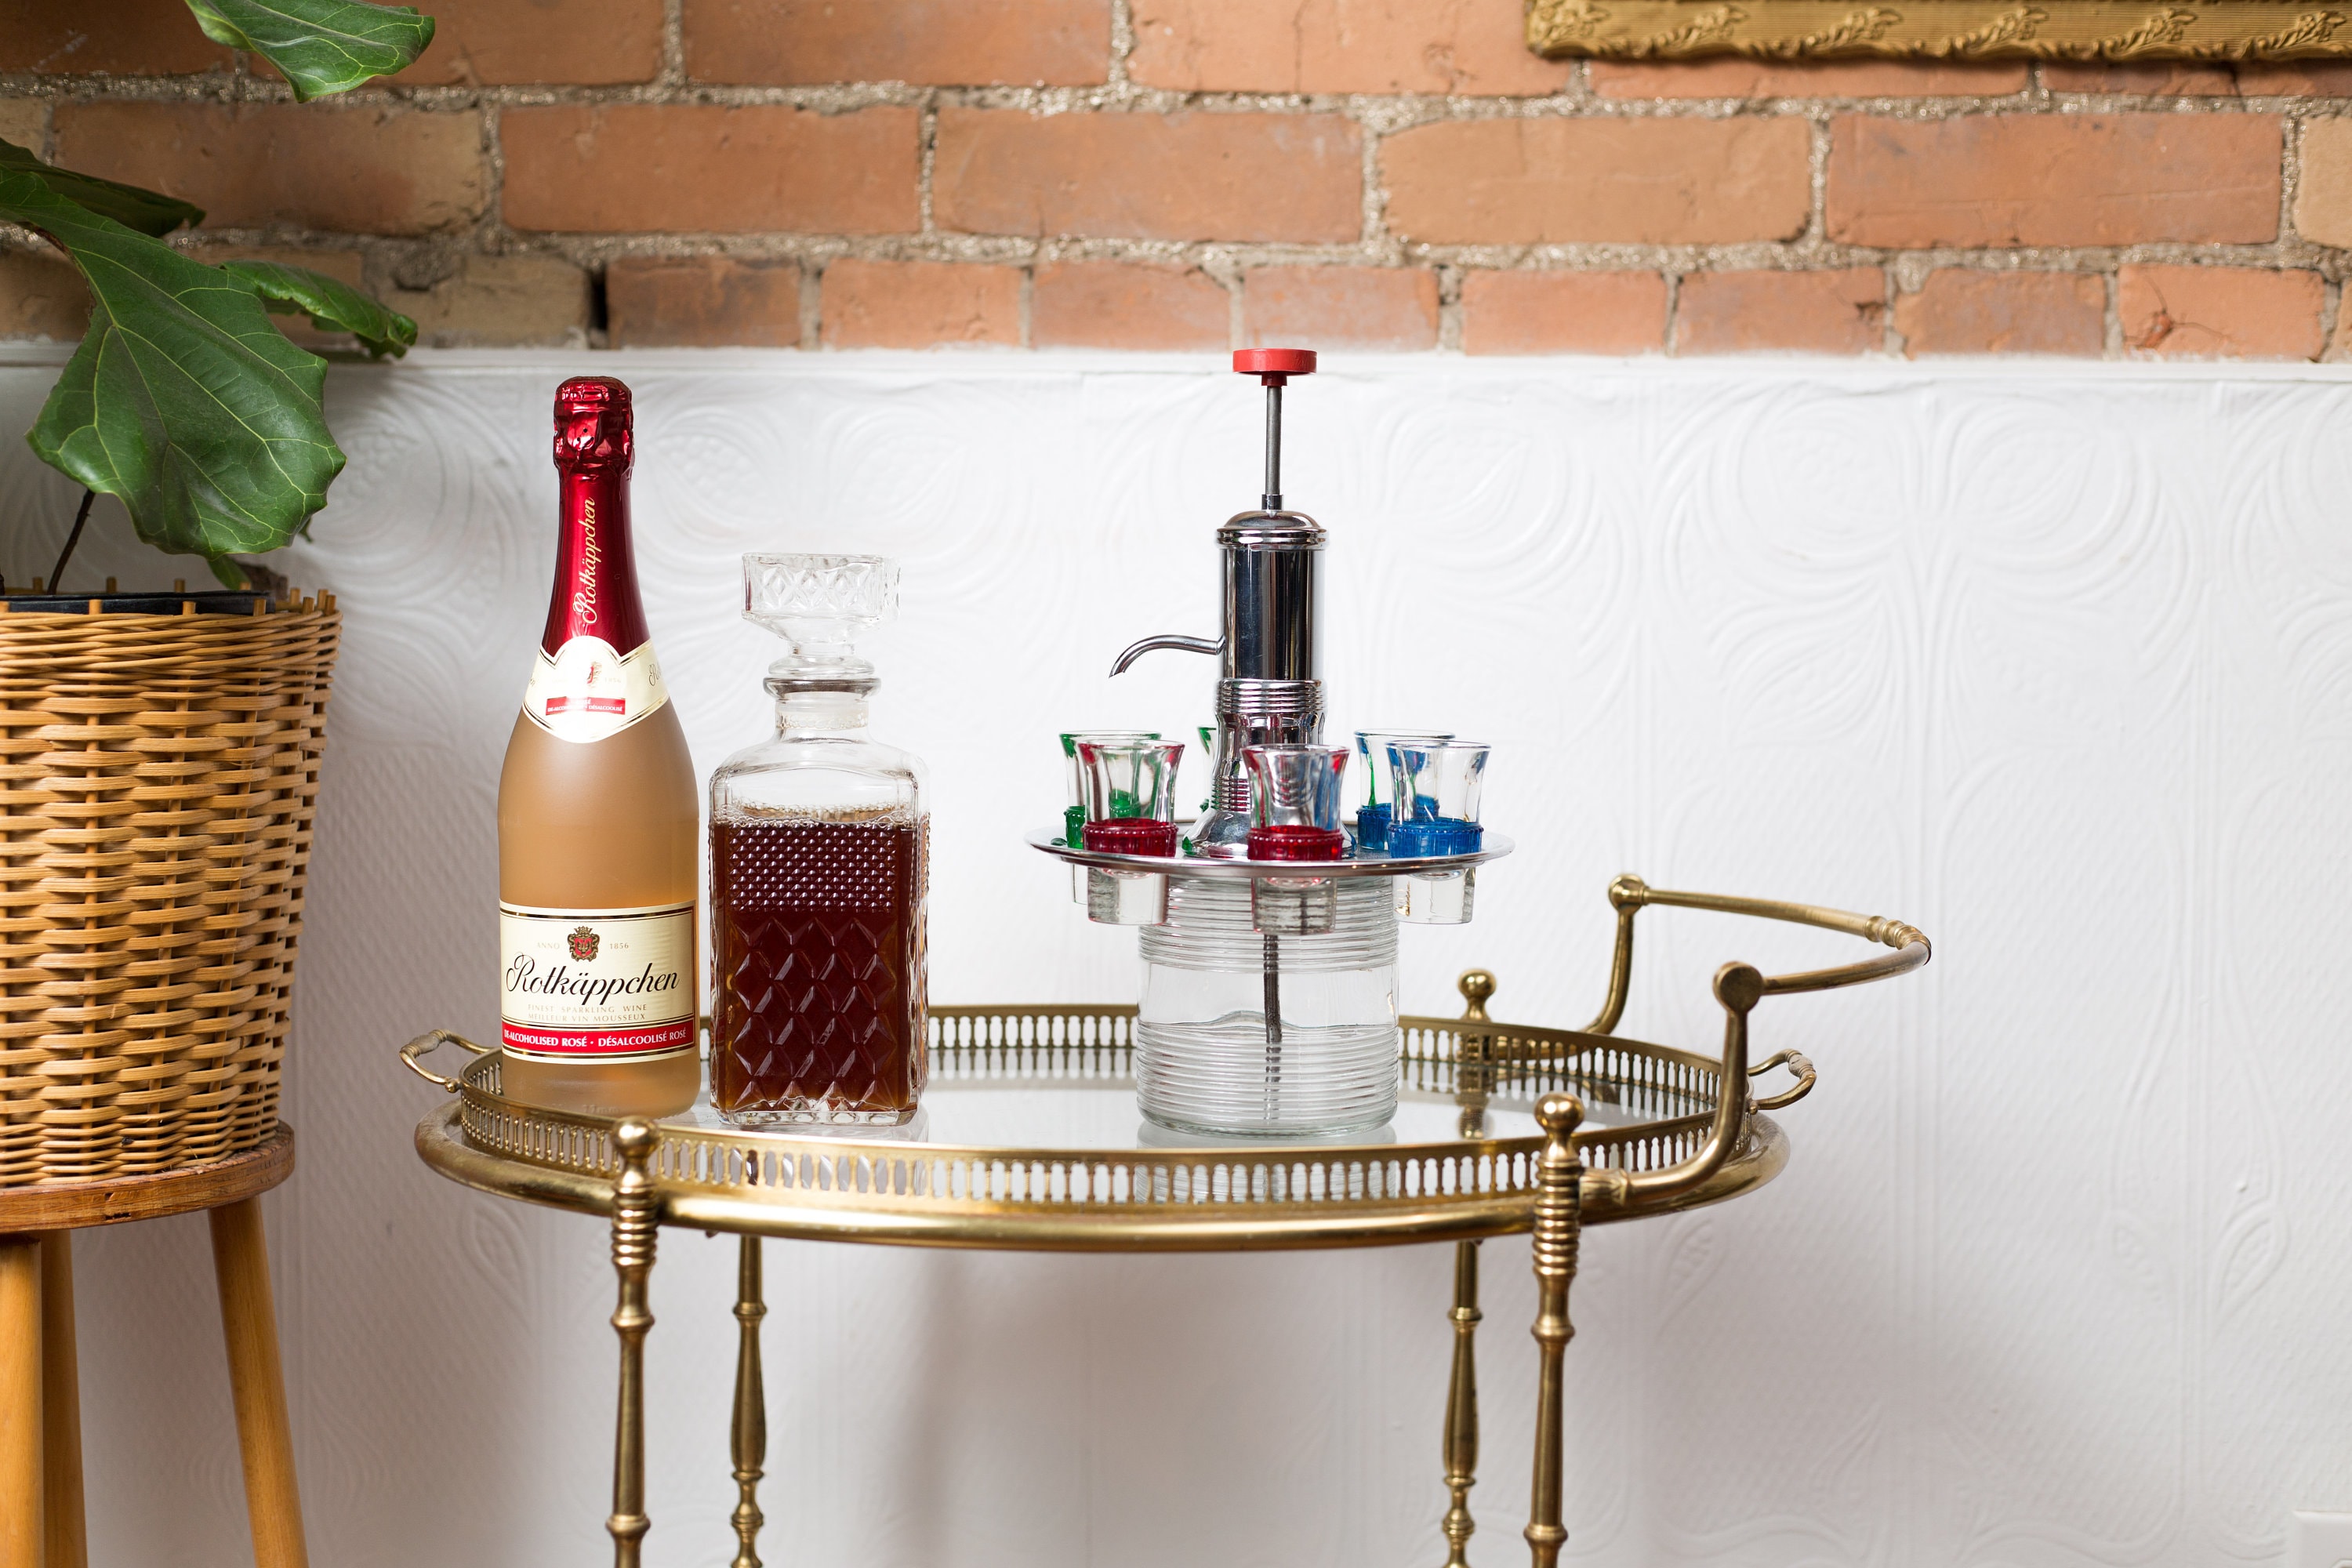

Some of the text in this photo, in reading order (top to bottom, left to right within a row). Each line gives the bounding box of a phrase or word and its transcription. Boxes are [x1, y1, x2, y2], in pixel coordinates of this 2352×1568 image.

[572, 497, 602, 624] Rotkäppchen
[506, 952, 680, 1005] Rotkäppchen
[528, 1013, 568, 1022] MEILLEUR
[593, 1013, 645, 1022] MOUSSEUX
[504, 1027, 687, 1047] DE-ALCOHOLISED ROSÉ DÉSALCOOLISÉ ROSÉ
